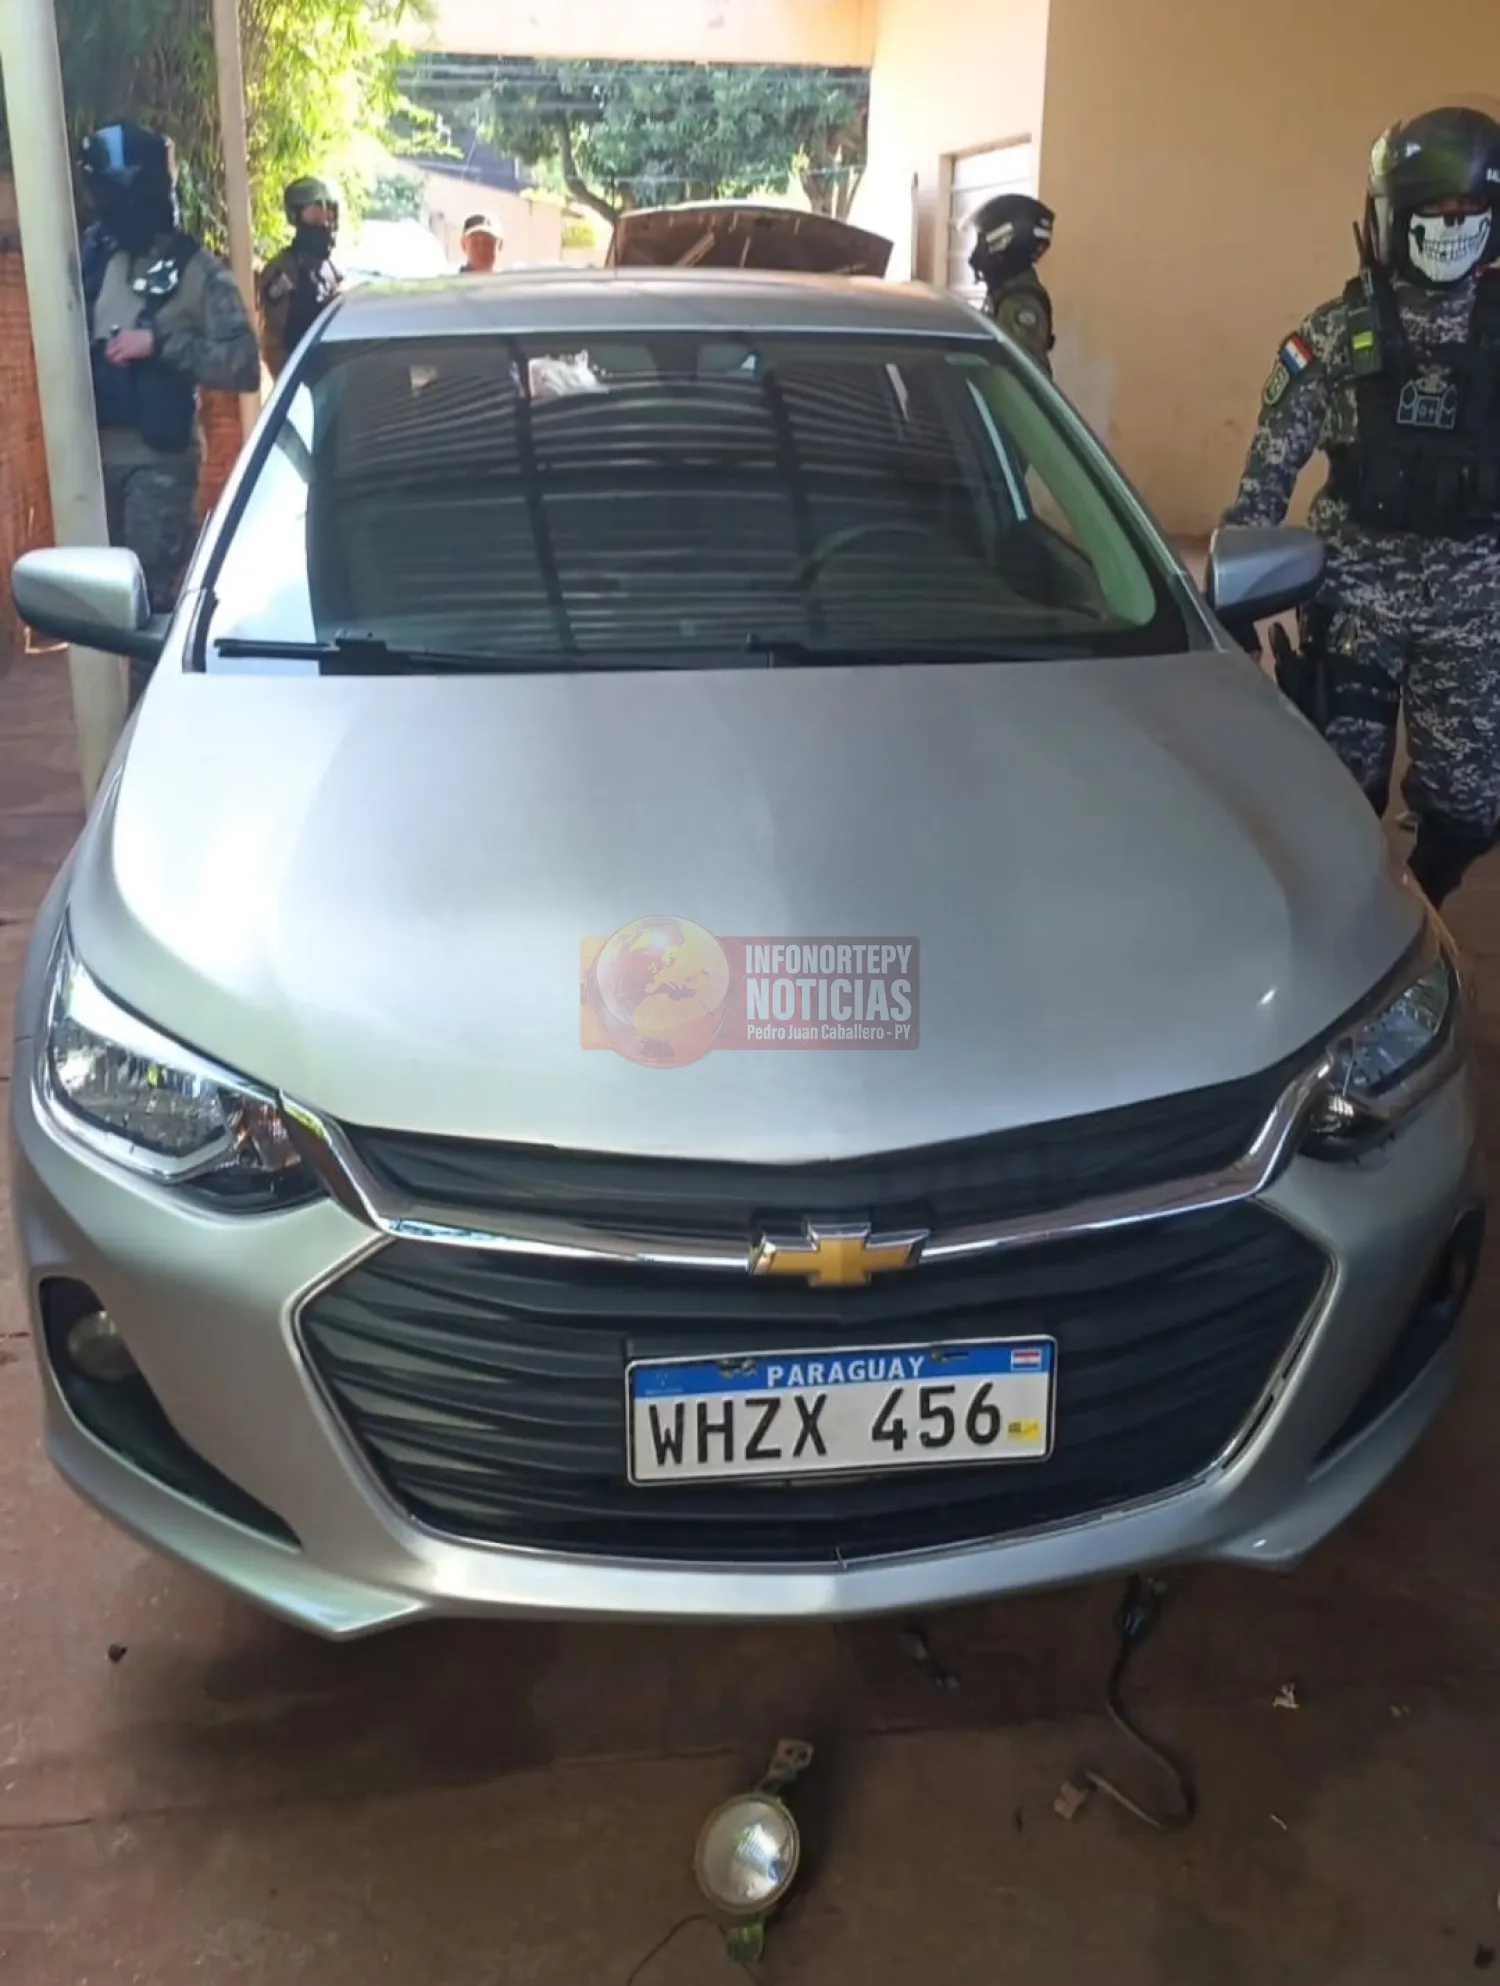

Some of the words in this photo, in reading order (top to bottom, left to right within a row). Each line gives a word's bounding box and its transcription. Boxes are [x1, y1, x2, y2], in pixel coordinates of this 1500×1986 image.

[766, 1355, 926, 1388] PARAGUAY
[649, 1392, 828, 1467] WHZX
[871, 1382, 1001, 1452] 456
